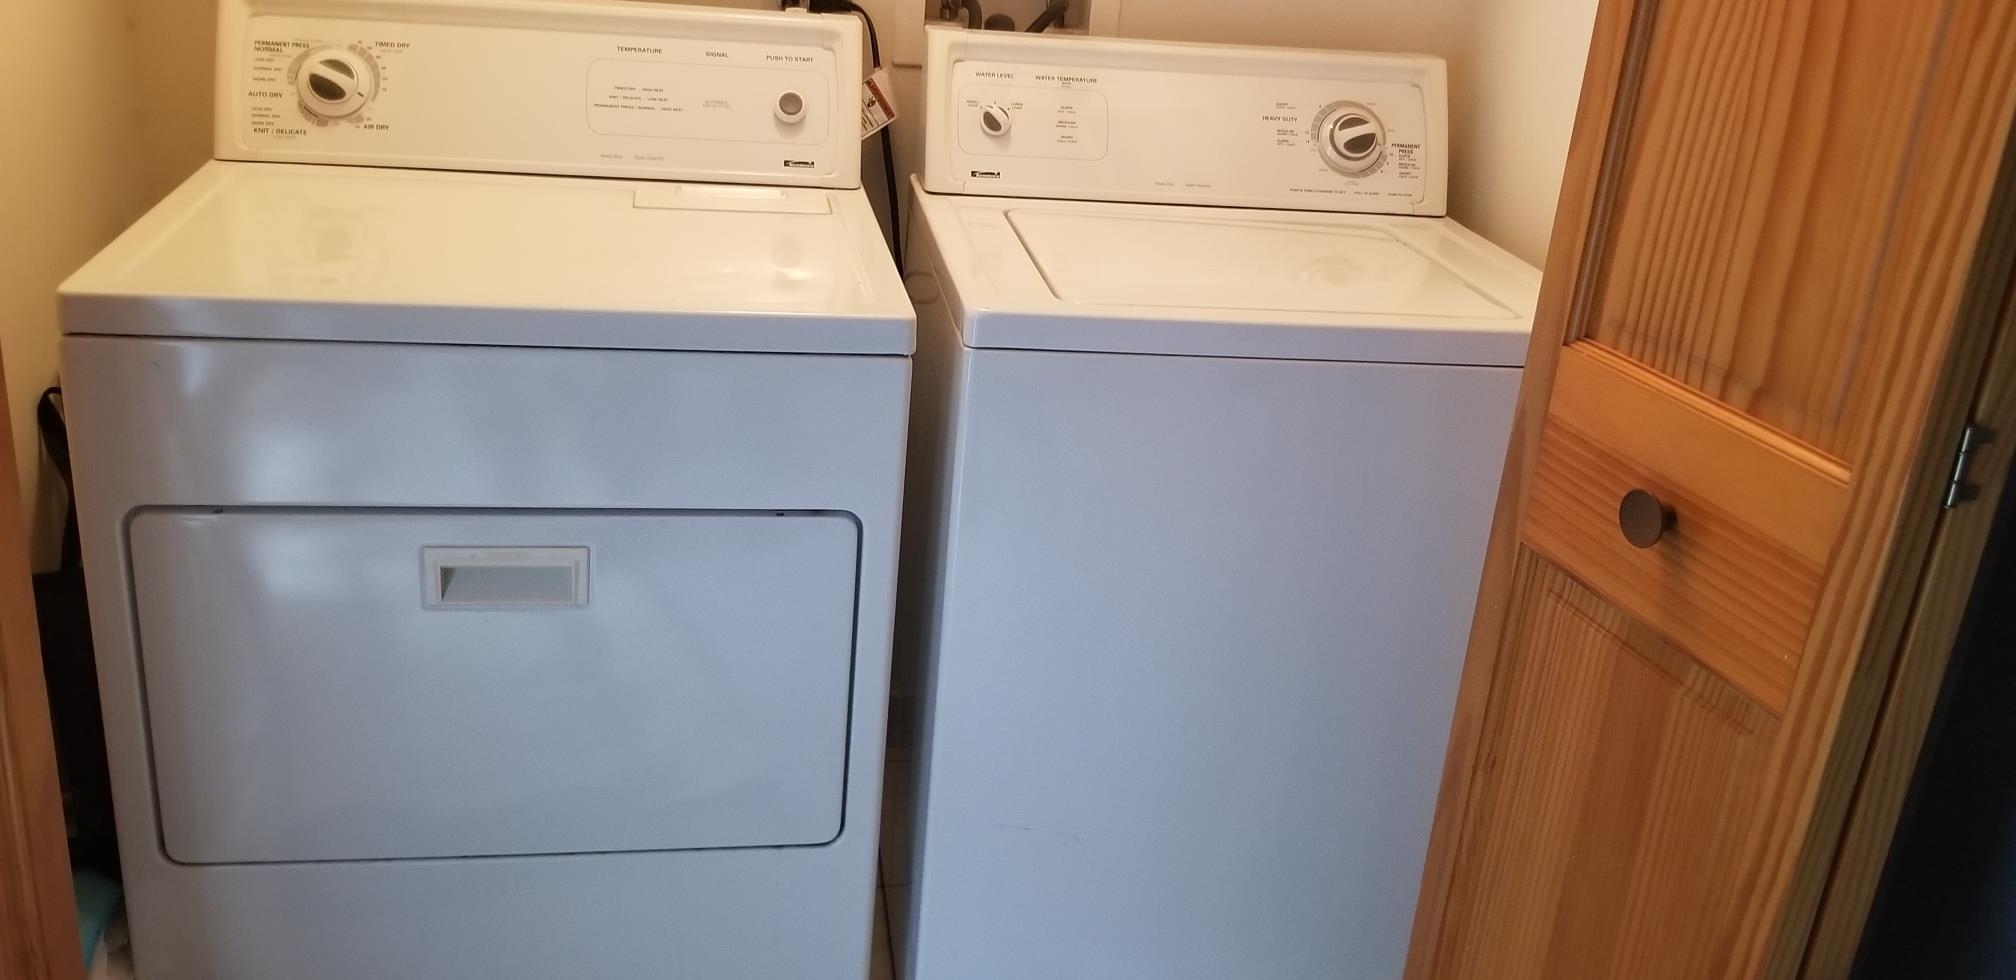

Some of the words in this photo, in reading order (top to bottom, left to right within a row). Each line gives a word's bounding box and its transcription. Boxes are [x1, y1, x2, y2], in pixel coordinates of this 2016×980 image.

[254, 40, 290, 48] PERMANENT
[617, 46, 663, 54] TEMPERATURE
[253, 127, 270, 135] KNIT
[276, 128, 307, 136] DELICATE
